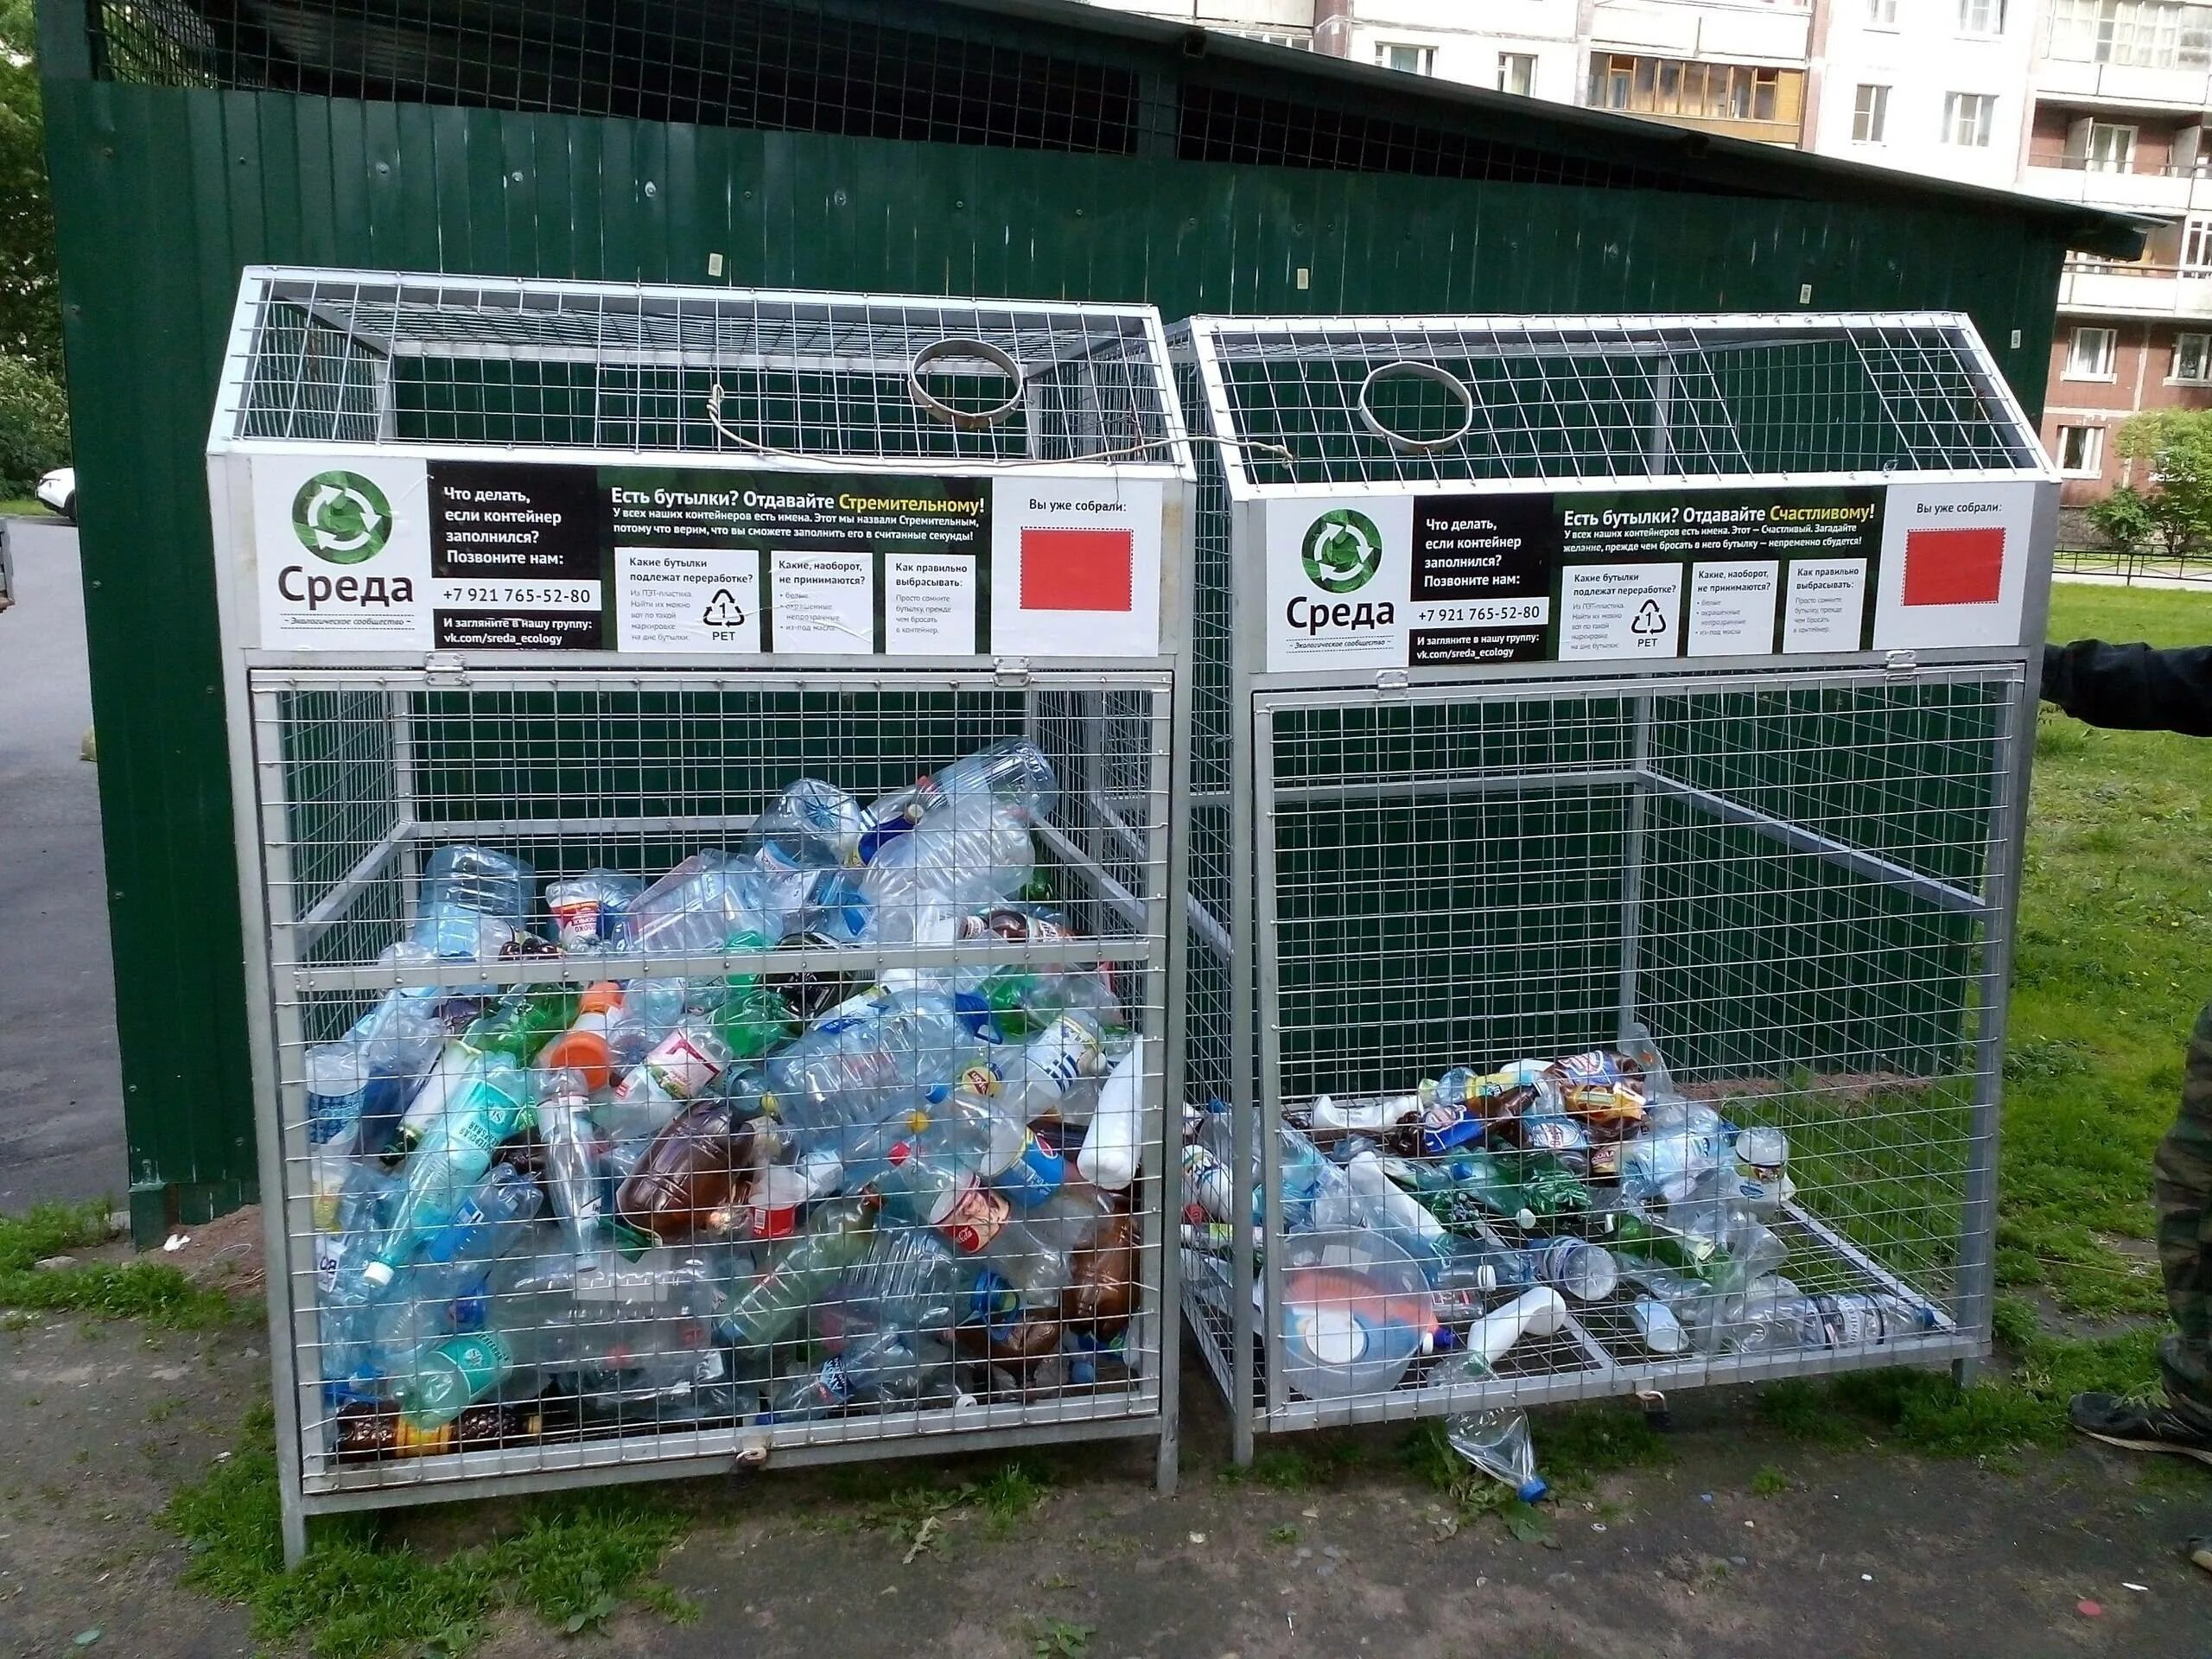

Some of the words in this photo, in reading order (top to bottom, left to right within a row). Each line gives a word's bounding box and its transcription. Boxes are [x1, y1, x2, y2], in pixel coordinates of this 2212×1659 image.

[443, 486, 471, 500] Что
[474, 491, 531, 503] делать,
[611, 486, 651, 504] Есть
[653, 488, 740, 508] бутылки?
[743, 491, 835, 509] Отдавайте
[838, 493, 985, 516] Стремительному!
[1029, 498, 1046, 510] Вы
[1049, 502, 1071, 512] уже
[1075, 500, 1126, 513] собрали:
[1916, 503, 1932, 513] Вы
[1934, 505, 1954, 515] уже
[1956, 502, 2001, 513] собрали:
[444, 511, 480, 521] если
[484, 510, 562, 525] контейнер
[613, 507, 620, 517] У
[648, 510, 683, 518] наших
[685, 510, 752, 522] контейнеров
[753, 512, 776, 521] есть
[814, 512, 836, 523] Этот
[856, 515, 897, 524] назвали
[899, 514, 979, 527] Стремительным,
[1563, 510, 1599, 526] Есть
[1602, 507, 1679, 528] бутылки?
[1682, 505, 1766, 524] Отдавайте
[1770, 504, 1875, 523] Счастливому!
[1426, 518, 1448, 531] Что
[1450, 520, 1497, 531] делать,
[446, 531, 539, 543] заполнился?
[613, 524, 652, 535] потому
[673, 525, 709, 536] верим,
[793, 529, 845, 537] заполнить
[874, 531, 926, 539] считанные
[929, 531, 973, 542] секунды!
[1564, 531, 1571, 539] У
[1572, 531, 1592, 539] всех
[1593, 530, 1623, 538] наших
[1624, 528, 1680, 537] контейнеров
[1731, 525, 1751, 534] Этот
[1761, 524, 1813, 533] Счастливый.
[1814, 524, 1857, 532] Загадайте
[1425, 539, 1453, 550] если
[1457, 536, 1521, 550] контейнер
[1605, 543, 1638, 553] прежде
[1659, 541, 1693, 551] бросать
[1722, 539, 1758, 550] бутылку
[1768, 539, 1821, 548] непременно
[1821, 537, 1861, 547] сбудется!
[447, 550, 525, 563] Позвоните
[530, 554, 563, 564] нам:
[629, 557, 660, 566] Какие
[664, 557, 707, 569] бутылки
[1424, 555, 1502, 568] заполнился?
[779, 560, 811, 570] Какие,
[814, 562, 862, 572] наоборот,
[895, 563, 913, 571] Как
[683, 574, 753, 584] переработке?
[1574, 574, 1600, 582] Какие
[1602, 573, 1638, 583] бутылки
[1698, 570, 1726, 579] Какие,
[1727, 569, 1768, 579] наоборот,
[1815, 569, 1859, 577] правильно
[793, 575, 865, 585] принимаются?
[895, 577, 962, 588] выбрасывать:
[1424, 575, 1489, 587] Позвоните
[1492, 575, 1520, 585] нам:
[1796, 581, 1853, 590] выбрасывать:
[278, 564, 415, 610] Среда
[1573, 588, 1616, 596] подлежат
[1618, 584, 1676, 595] переработке?
[1709, 582, 1770, 593] принимаются?
[443, 588, 462, 601] +7
[467, 588, 498, 601] 921
[504, 588, 590, 602] 765-52-80
[1286, 595, 1395, 636] Среда
[1419, 609, 1434, 621] +7
[1439, 608, 1464, 621] 921
[1469, 606, 1540, 620] 765-52-80
[443, 617, 453, 627] И
[454, 619, 509, 628] загляните
[521, 620, 550, 631] нашу
[551, 620, 592, 631] группу:
[443, 632, 562, 645] vk.com/sreda_ecology
[712, 631, 736, 641] PET
[1417, 636, 1424, 645] И
[1481, 635, 1505, 644] нашу
[1506, 634, 1539, 644] группу:
[1637, 638, 1658, 648] PET
[1416, 648, 1514, 659] vk.com/sreda_ecology
